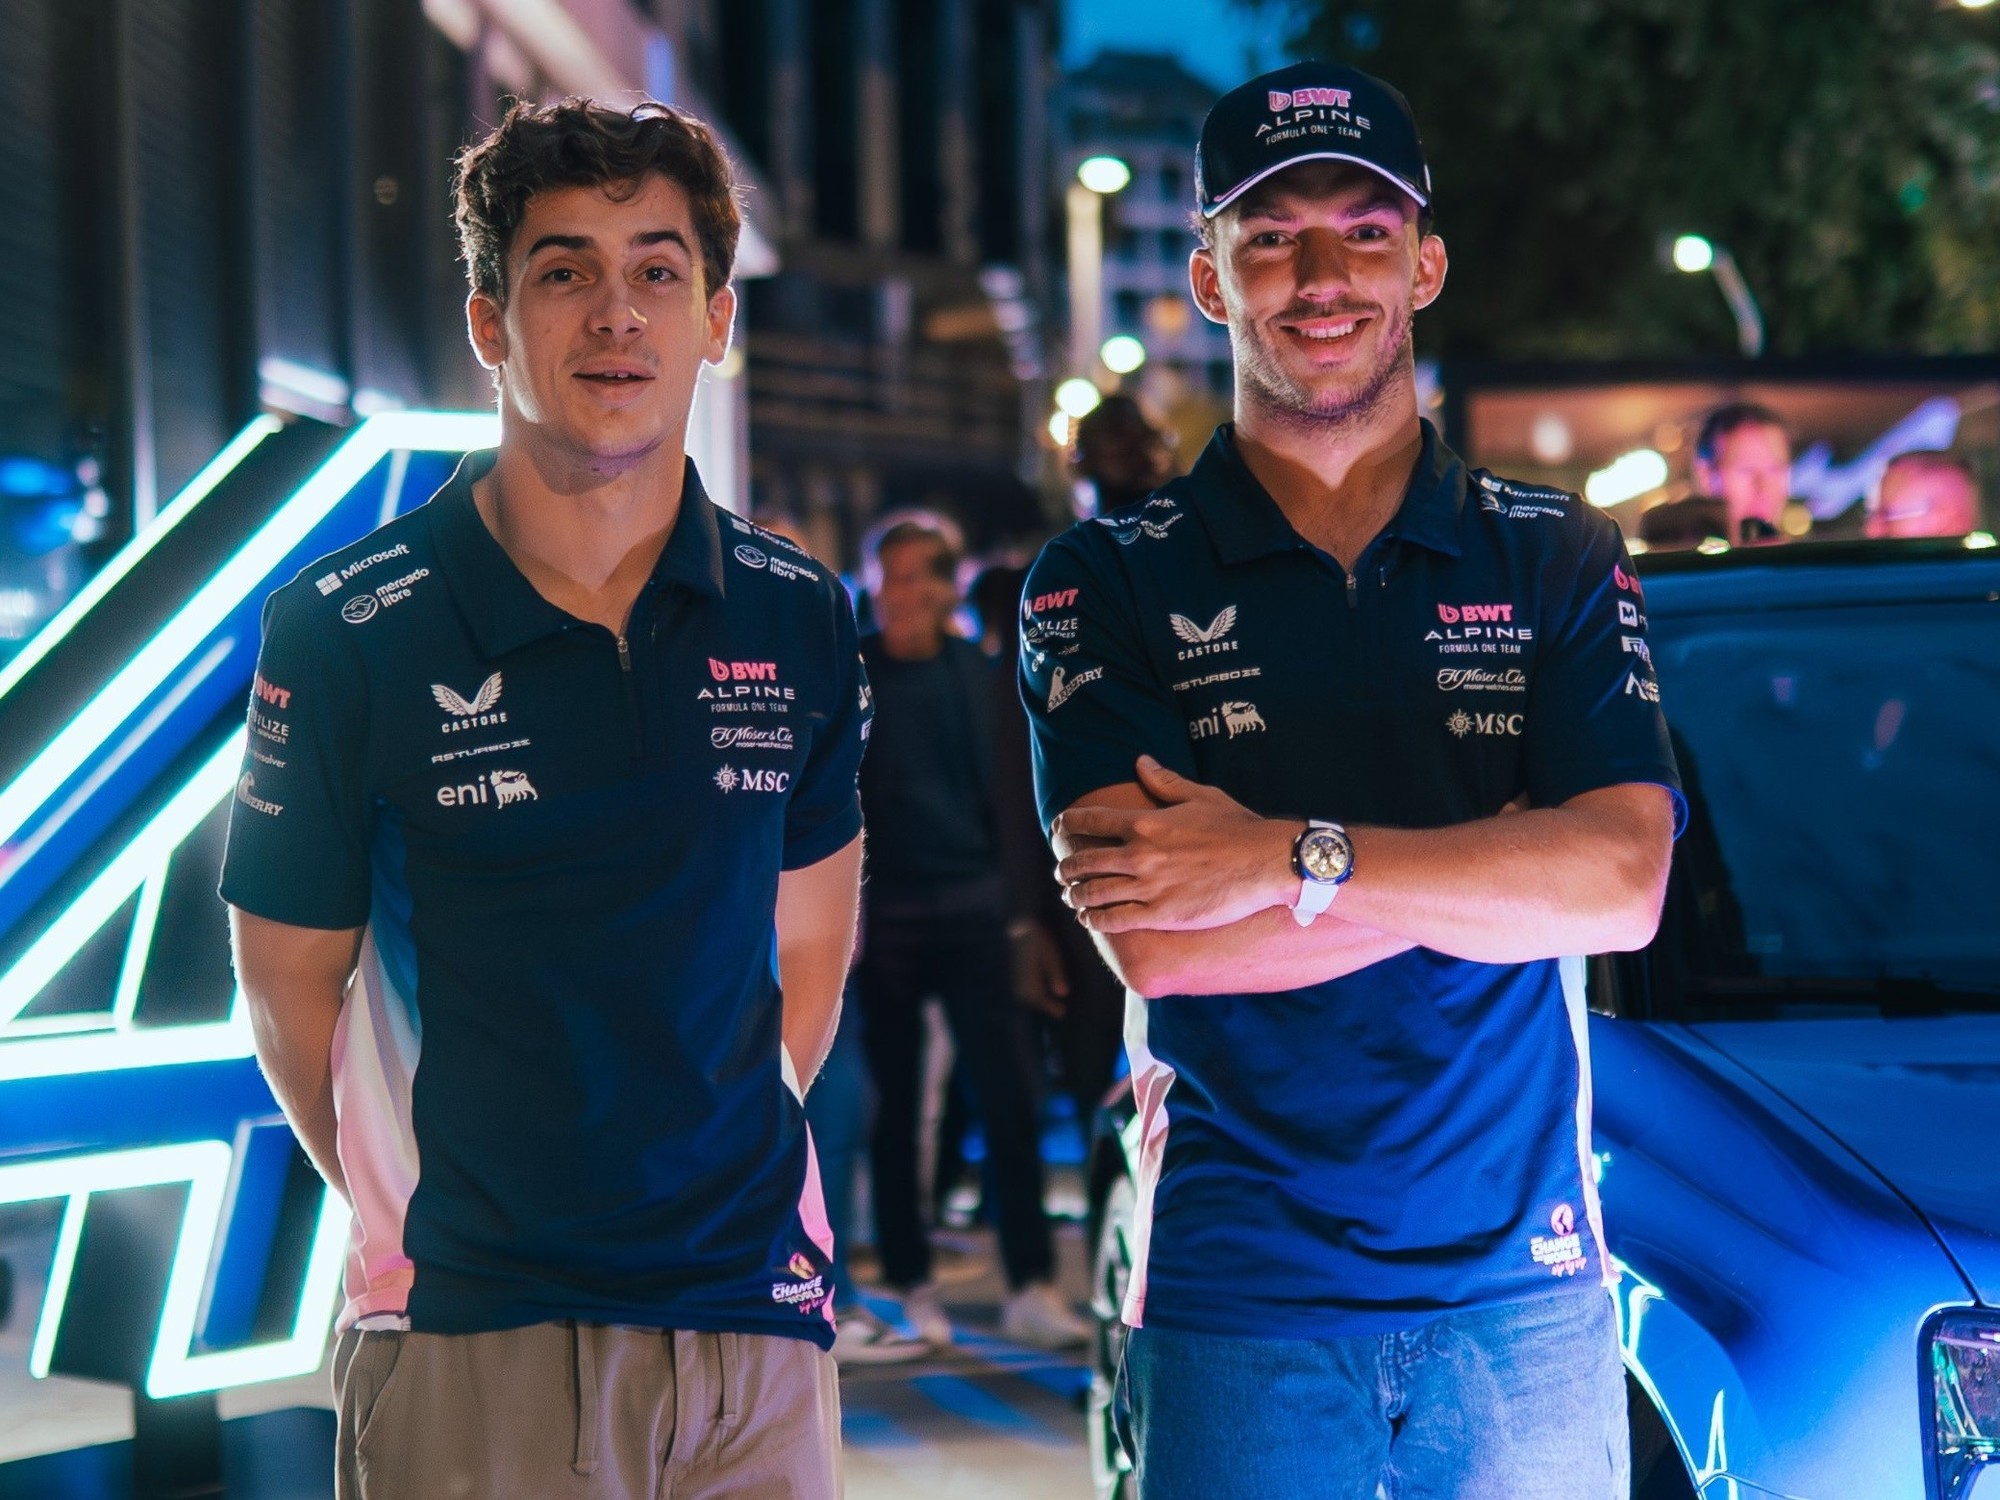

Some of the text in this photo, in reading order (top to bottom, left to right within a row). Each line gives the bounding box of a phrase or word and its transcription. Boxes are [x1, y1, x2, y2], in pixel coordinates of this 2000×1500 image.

[1292, 87, 1351, 108] BWT
[1255, 109, 1371, 137] ALPINE
[1265, 127, 1307, 146] FORMULA
[1337, 126, 1361, 139] TEAM
[1510, 504, 1565, 518] mercado
[340, 543, 411, 580] Microsoft
[769, 556, 819, 582] mercado
[769, 562, 797, 581] libre
[376, 568, 430, 598] mercado
[380, 588, 412, 608] libre
[1033, 588, 1079, 612] BWT
[1461, 604, 1513, 622] BWT
[1424, 627, 1533, 641] ALPINE
[1177, 640, 1239, 661] CASTORE
[1439, 643, 1521, 654] FORMULA ONE TEAM
[731, 662, 777, 681] BWT
[697, 686, 795, 700] ALPINE
[711, 702, 788, 713] FORMULA ONE TEAM
[441, 712, 508, 733] CASTORE
[1188, 707, 1220, 740] eni
[1474, 713, 1524, 736] MSC
[437, 774, 489, 806] eni
[741, 769, 790, 793] MSC
[1531, 1233, 1580, 1257] CHANGE
[1543, 1247, 1582, 1266] WORLD
[772, 1275, 822, 1301] CHANGE
[785, 1287, 824, 1305] WORLD
